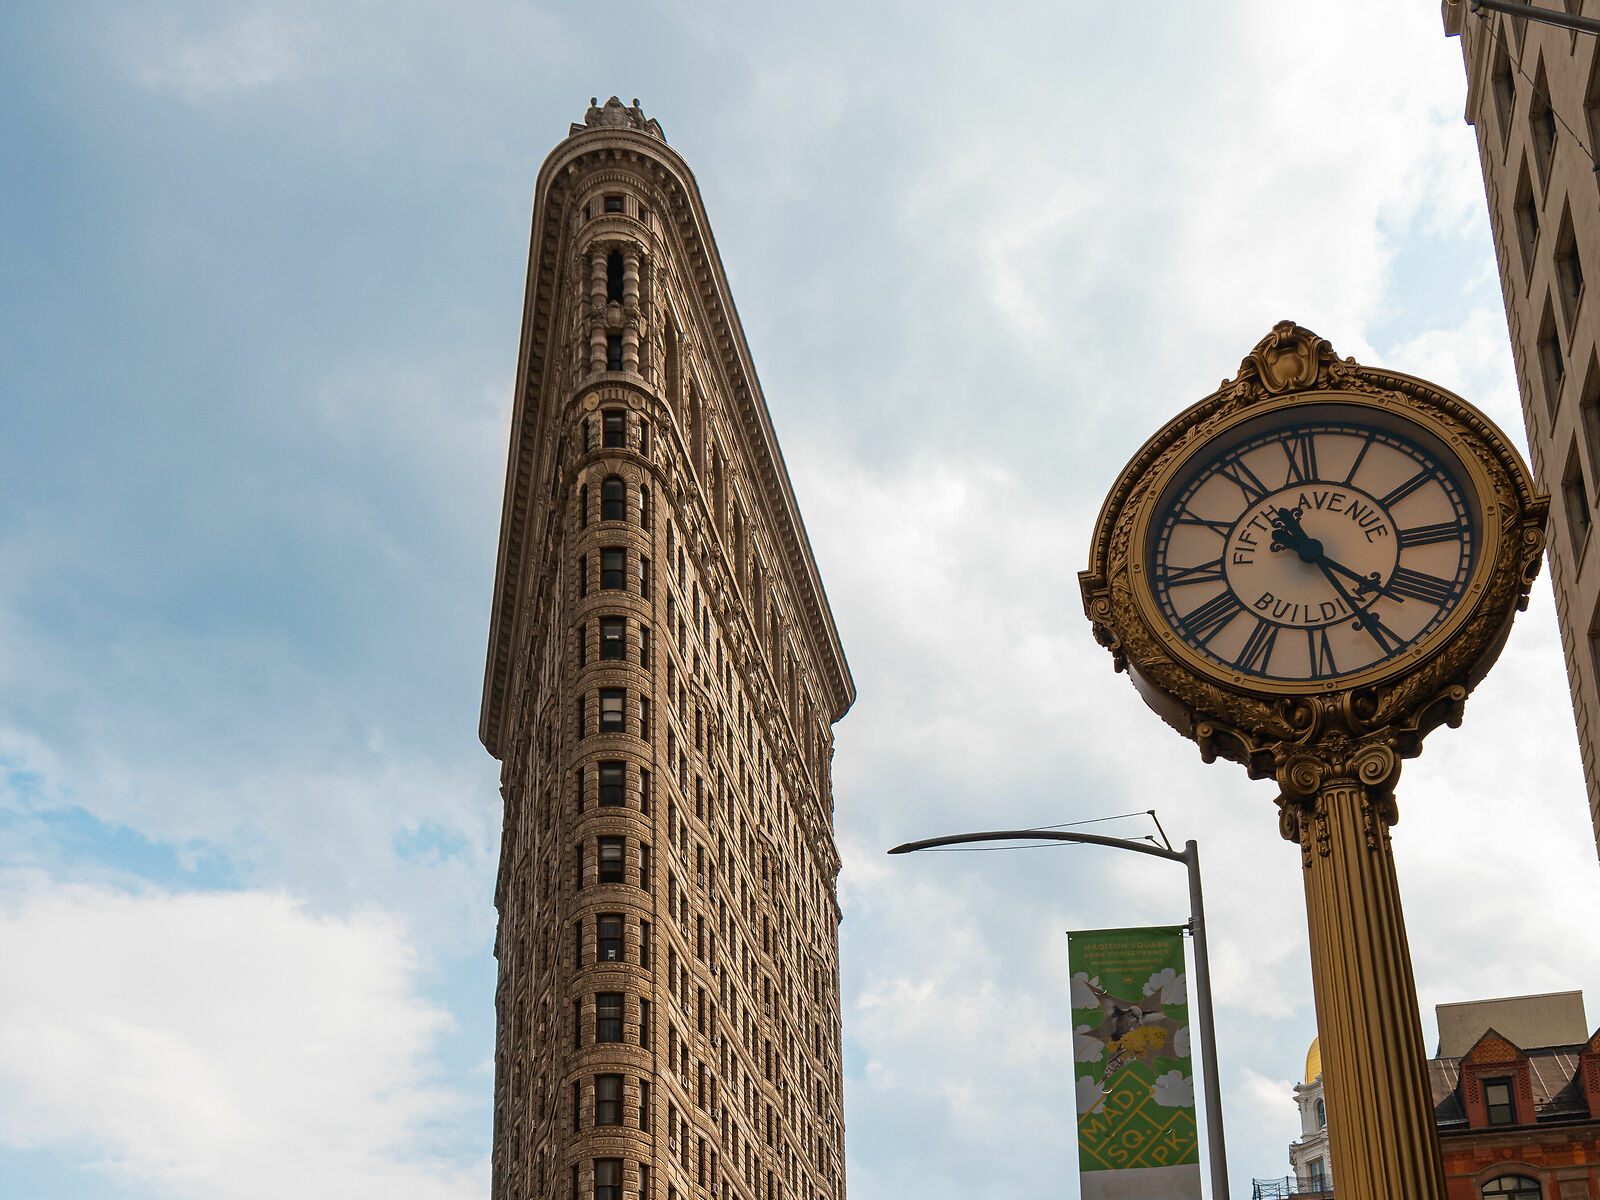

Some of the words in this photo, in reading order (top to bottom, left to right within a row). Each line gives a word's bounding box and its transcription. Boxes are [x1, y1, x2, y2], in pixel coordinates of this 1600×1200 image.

[1281, 435, 1318, 485] XII
[1218, 459, 1271, 506] XI
[1378, 468, 1436, 512] II
[1175, 508, 1235, 538] X
[1233, 504, 1279, 565] FIFTH
[1298, 491, 1388, 544] AVENUE
[1398, 520, 1461, 549] III
[1166, 557, 1227, 587] IX
[1179, 590, 1247, 648] VIII
[1233, 618, 1281, 676] VII
[1306, 628, 1340, 679] VI
[1083, 943, 1128, 951] MADISON
[1131, 941, 1169, 949] SQUARE
[1108, 949, 1169, 957] CONSERVANCY
[1081, 1090, 1142, 1142] MAD.
[1107, 1129, 1152, 1163] SQ.
[1151, 1128, 1194, 1166] PK.
